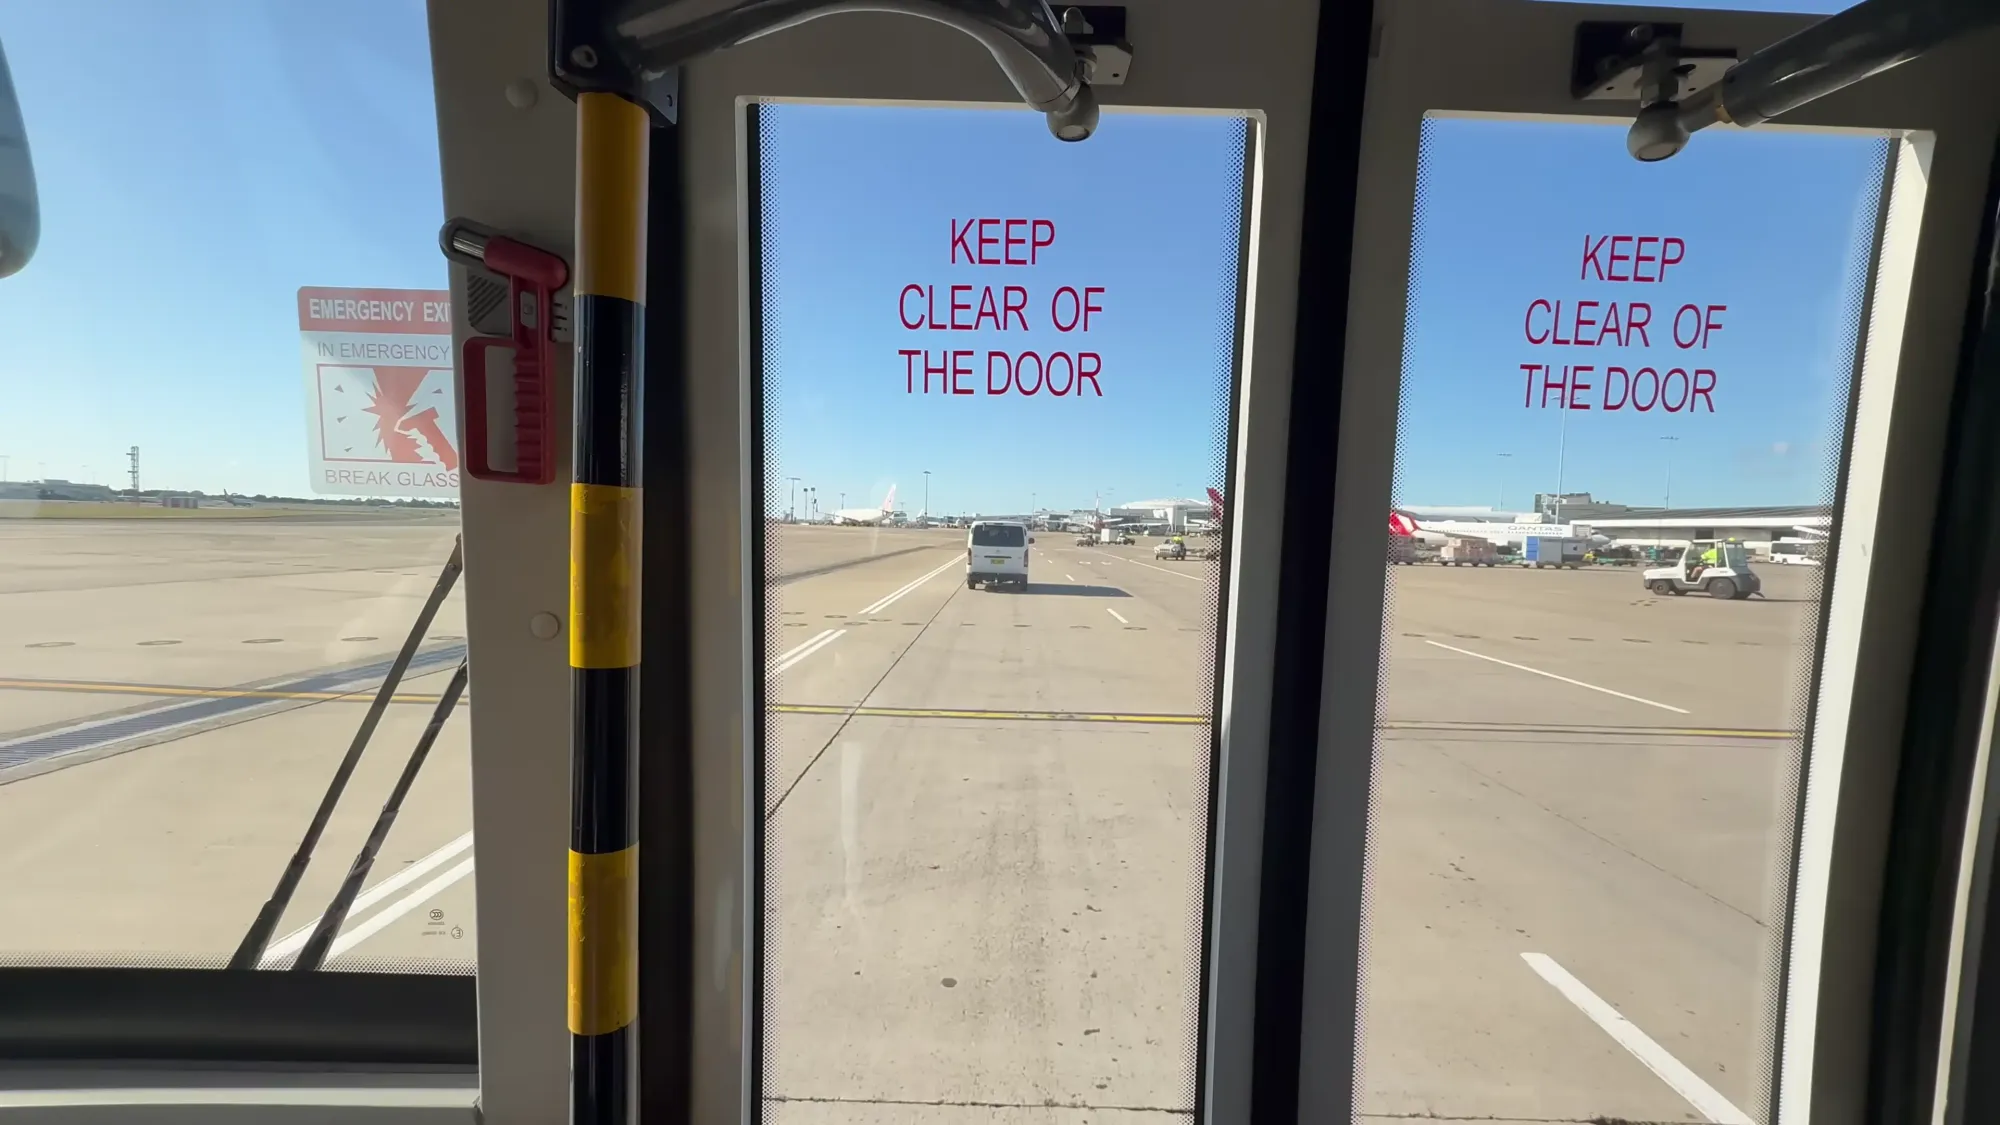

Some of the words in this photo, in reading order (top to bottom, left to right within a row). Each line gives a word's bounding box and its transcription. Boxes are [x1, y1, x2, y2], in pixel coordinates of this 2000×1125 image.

[951, 218, 1056, 265] KEEP
[1581, 234, 1686, 282] KEEP
[309, 298, 414, 322] EMERGENCY
[899, 283, 1029, 331] CLEAR
[1051, 286, 1105, 332] OF
[1524, 298, 1652, 347] CLEAR
[1672, 303, 1727, 349] OF
[317, 341, 335, 357] IN
[340, 342, 450, 361] EMERGENCY
[898, 349, 975, 395] THE
[987, 350, 1103, 397] DOOR
[1519, 363, 1594, 410] THE
[1603, 366, 1717, 413] DOOR
[325, 469, 392, 485] BREAK
[397, 471, 459, 488] GLASS
